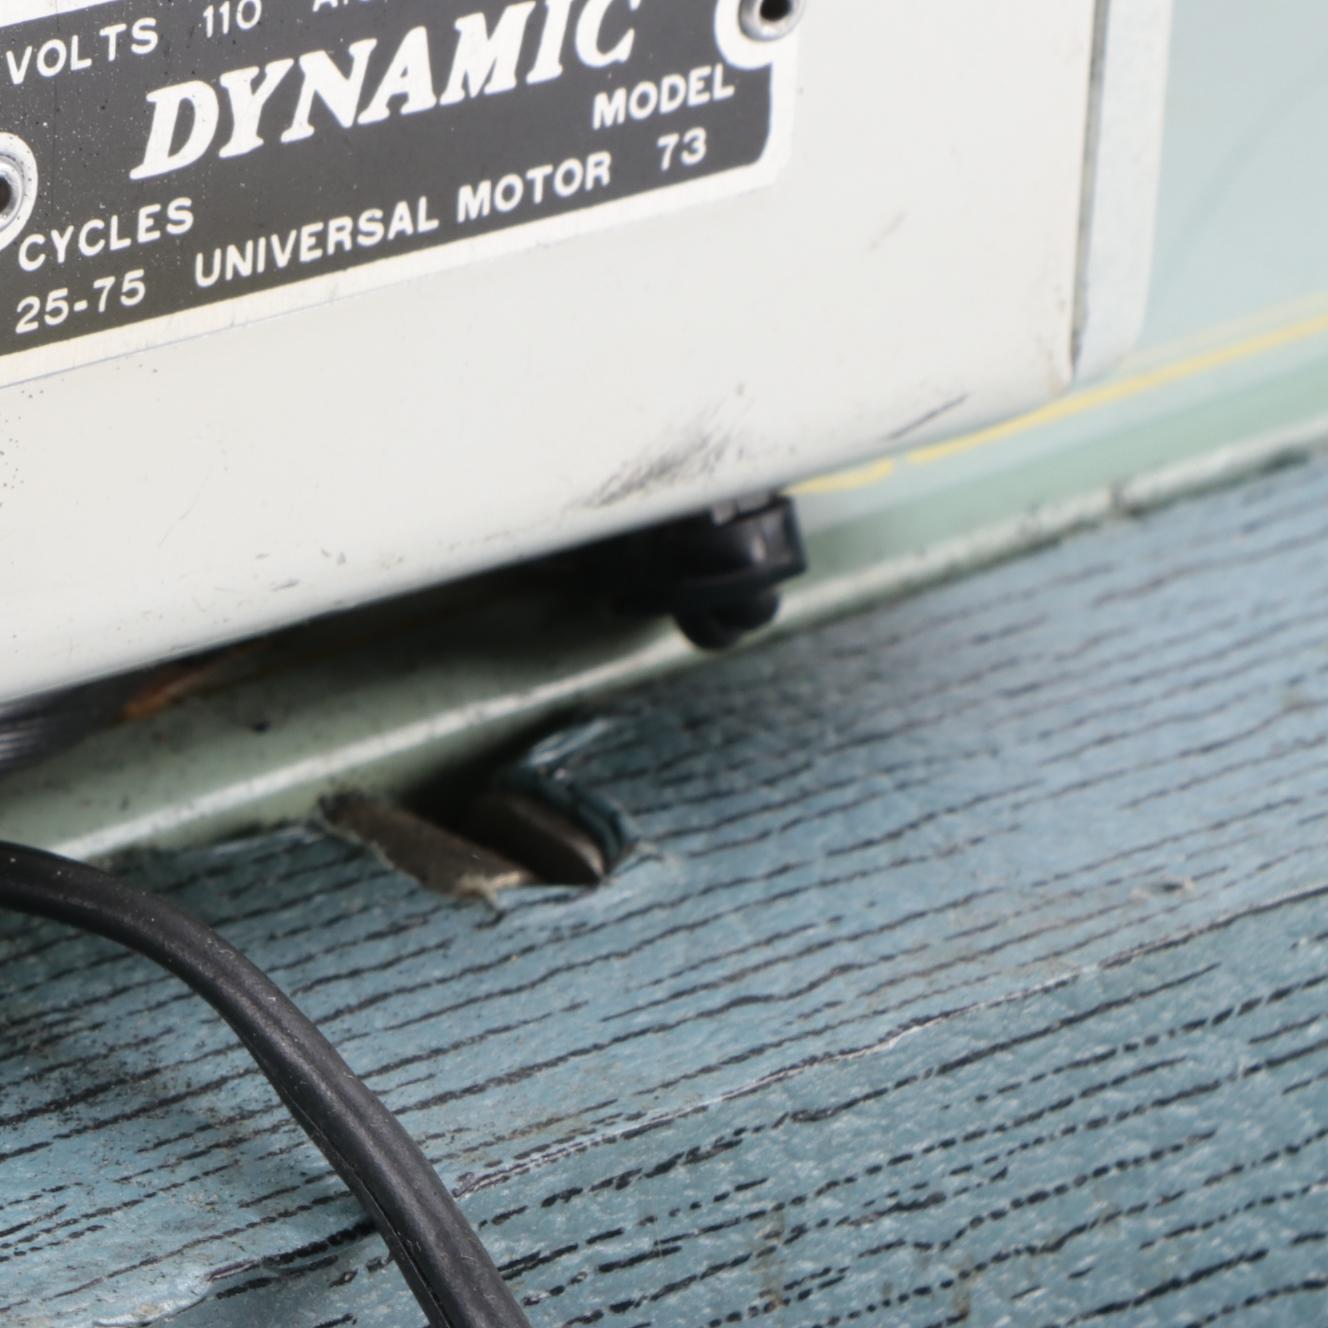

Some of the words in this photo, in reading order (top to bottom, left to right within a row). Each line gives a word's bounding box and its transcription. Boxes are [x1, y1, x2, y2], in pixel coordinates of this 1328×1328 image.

[4, 17, 159, 85] VOLTS
[592, 62, 735, 130] MODEL
[15, 268, 146, 334] 25-75
[195, 195, 440, 288] UNIVERSAL
[457, 150, 612, 223] MOTOR
[657, 126, 707, 171] 73
[18, 197, 194, 272] CYCLES
